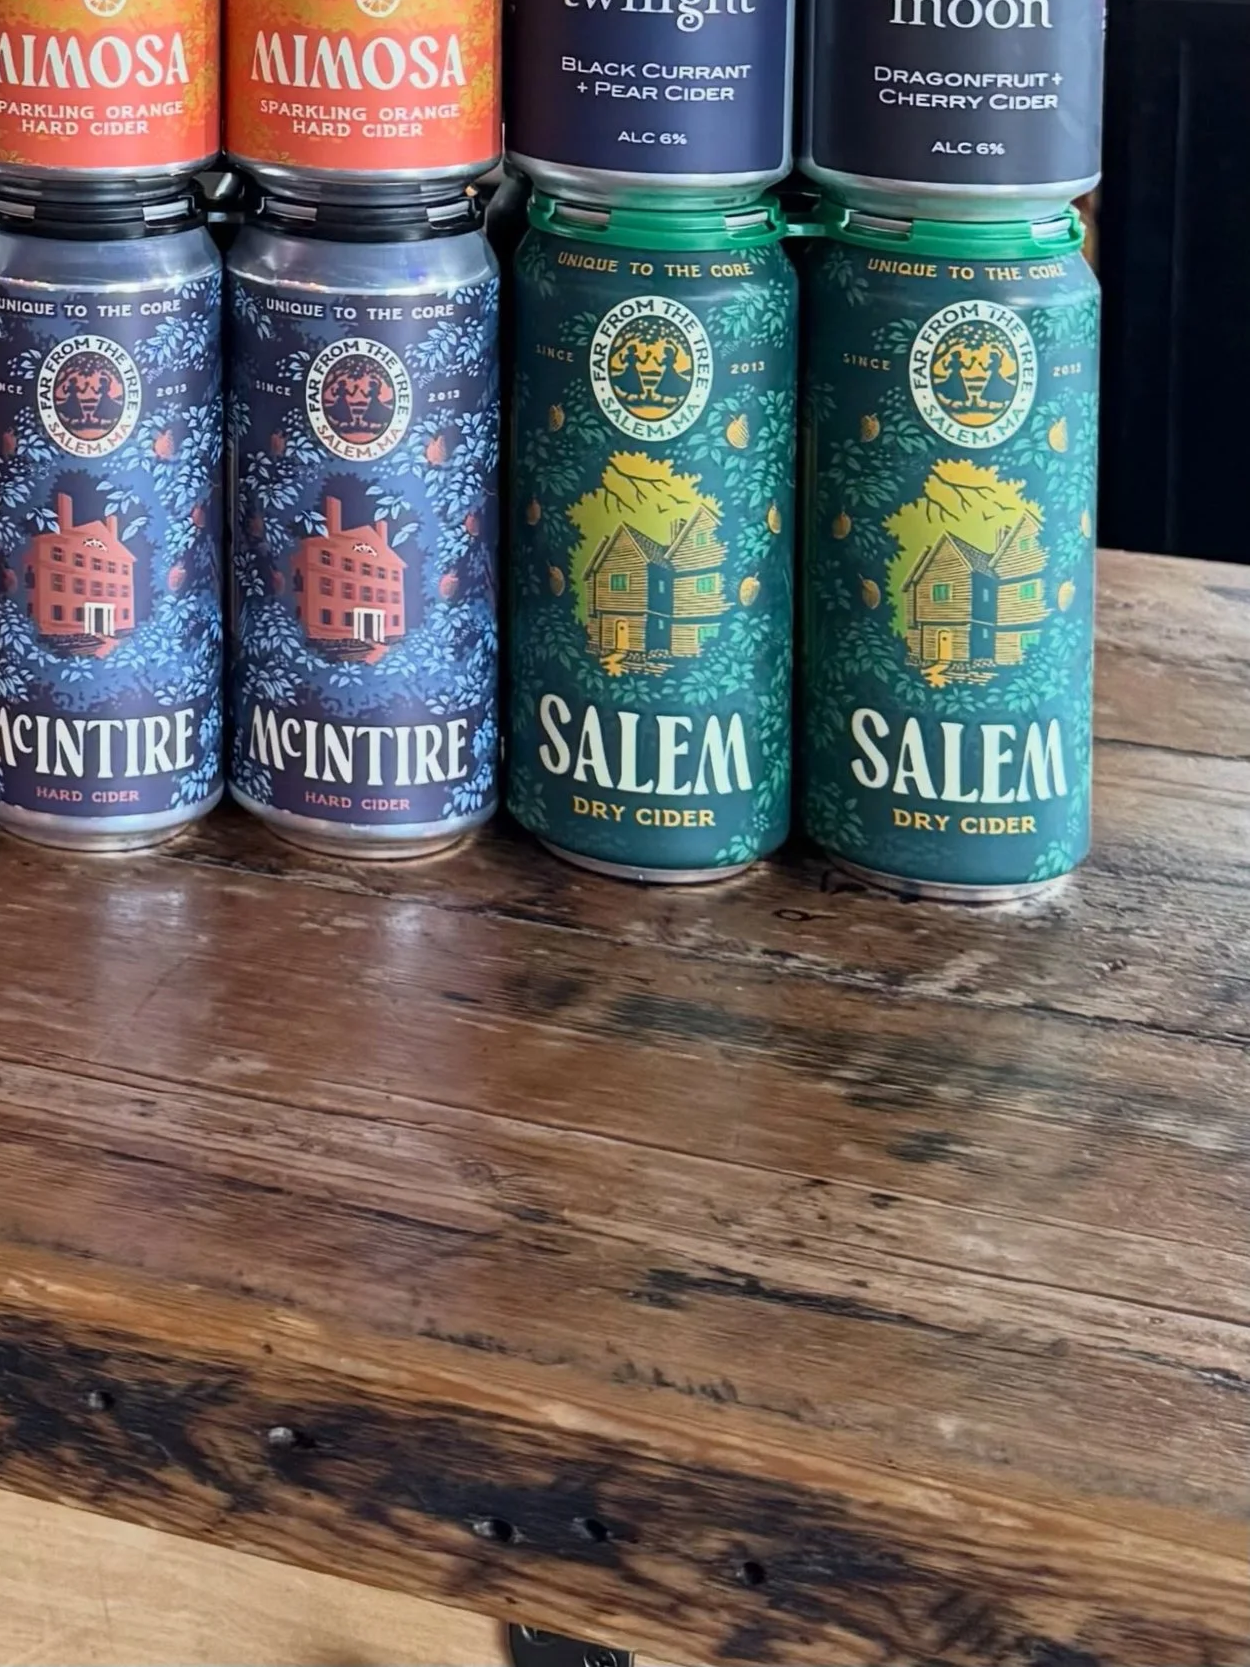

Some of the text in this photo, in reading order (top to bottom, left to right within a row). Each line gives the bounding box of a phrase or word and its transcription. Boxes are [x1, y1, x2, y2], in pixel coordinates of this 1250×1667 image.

[251, 30, 467, 91] MIMOSA
[561, 56, 752, 80] BLACK CURRANT
[874, 66, 1048, 88] DRAGONFRUIT
[594, 81, 658, 100] PEAR
[665, 85, 735, 101] CIDER
[879, 88, 1059, 110] CHERRY CIDER
[105, 100, 184, 119] ORANGE
[260, 99, 461, 121] SPARKLING ORANGE
[21, 119, 150, 136] HARD CIDER
[293, 120, 423, 138] HARD CIDER
[617, 130, 688, 145] ALC 6%
[931, 141, 1006, 155] ALC 6%
[539, 693, 753, 796] SALEM
[851, 708, 1068, 804] SALEM
[36, 786, 140, 803] HARD CIDER
[304, 791, 411, 811] HARD CIDER
[573, 795, 716, 827] DRY CIDER
[893, 808, 1037, 835] DRY CIDER
